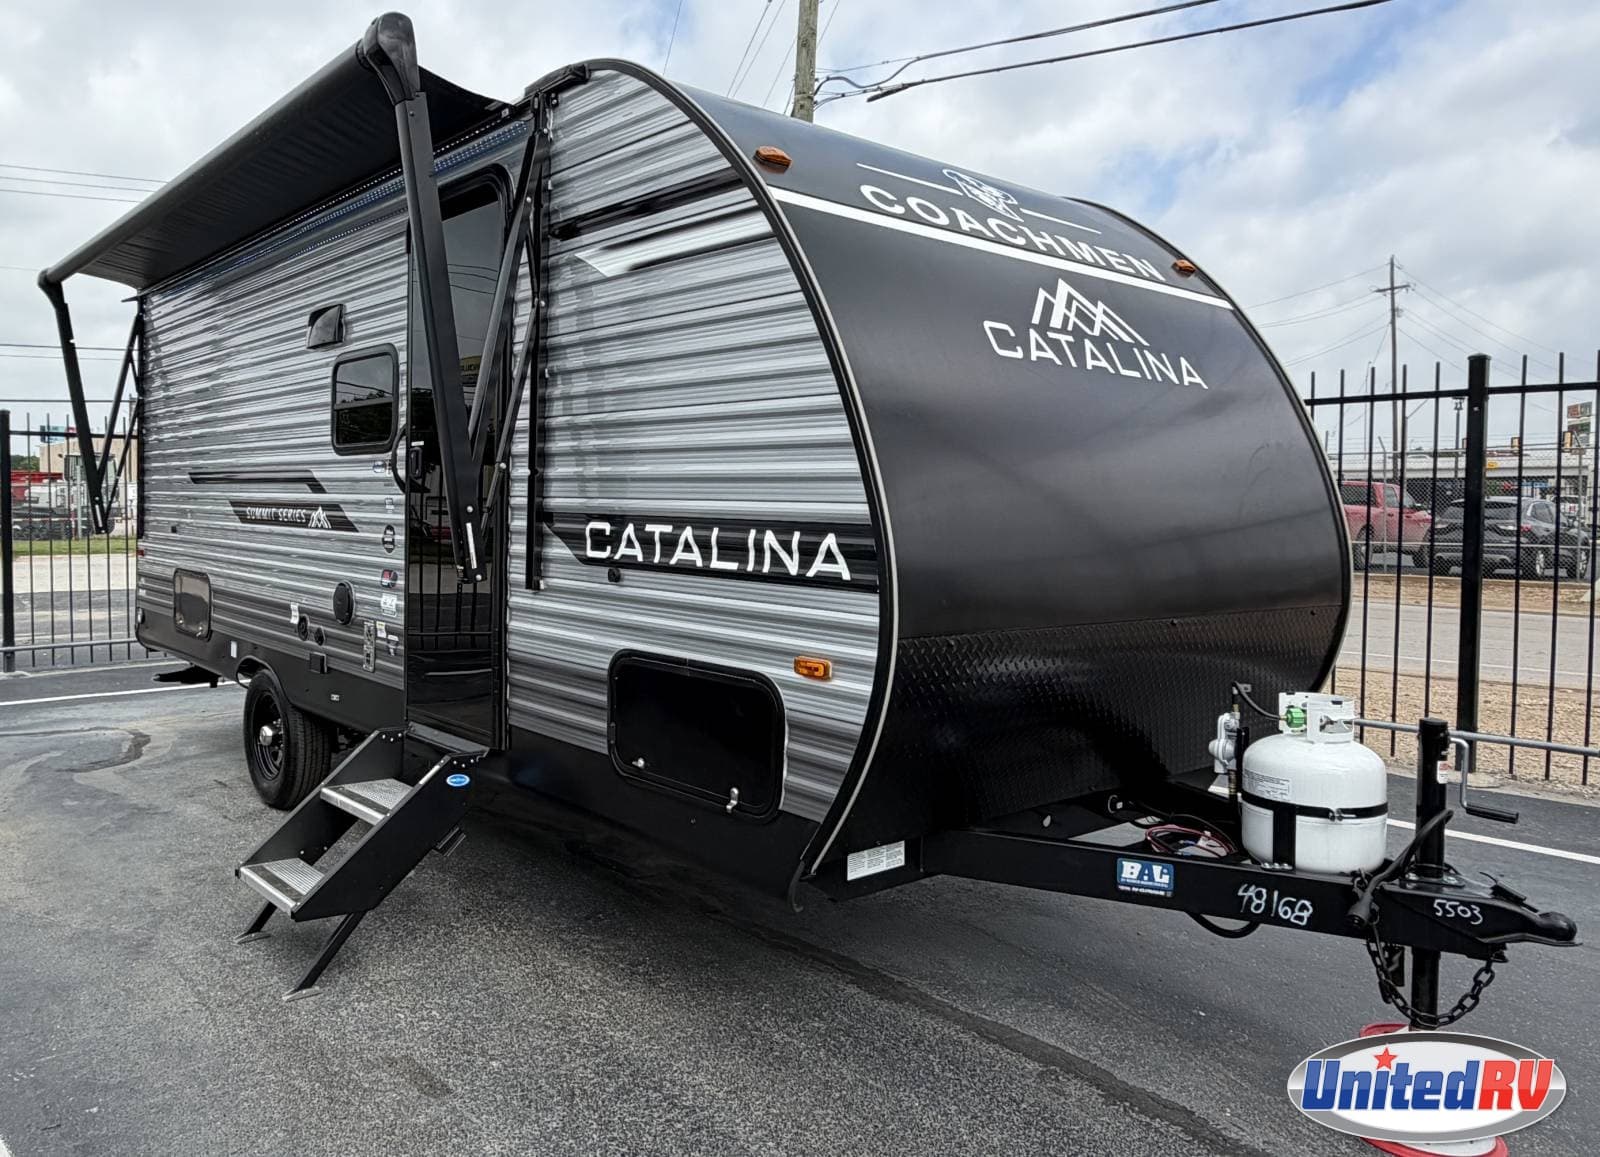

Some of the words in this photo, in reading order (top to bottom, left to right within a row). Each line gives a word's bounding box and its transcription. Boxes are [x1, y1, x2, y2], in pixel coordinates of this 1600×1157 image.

[860, 184, 1166, 281] COACHMEN
[983, 320, 1208, 389] CATALINA
[246, 506, 276, 520] SUMMIT
[278, 507, 306, 522] SERIES
[585, 521, 851, 580] CATALINA
[1237, 883, 1313, 926] 48168
[1432, 899, 1483, 925] 5503
